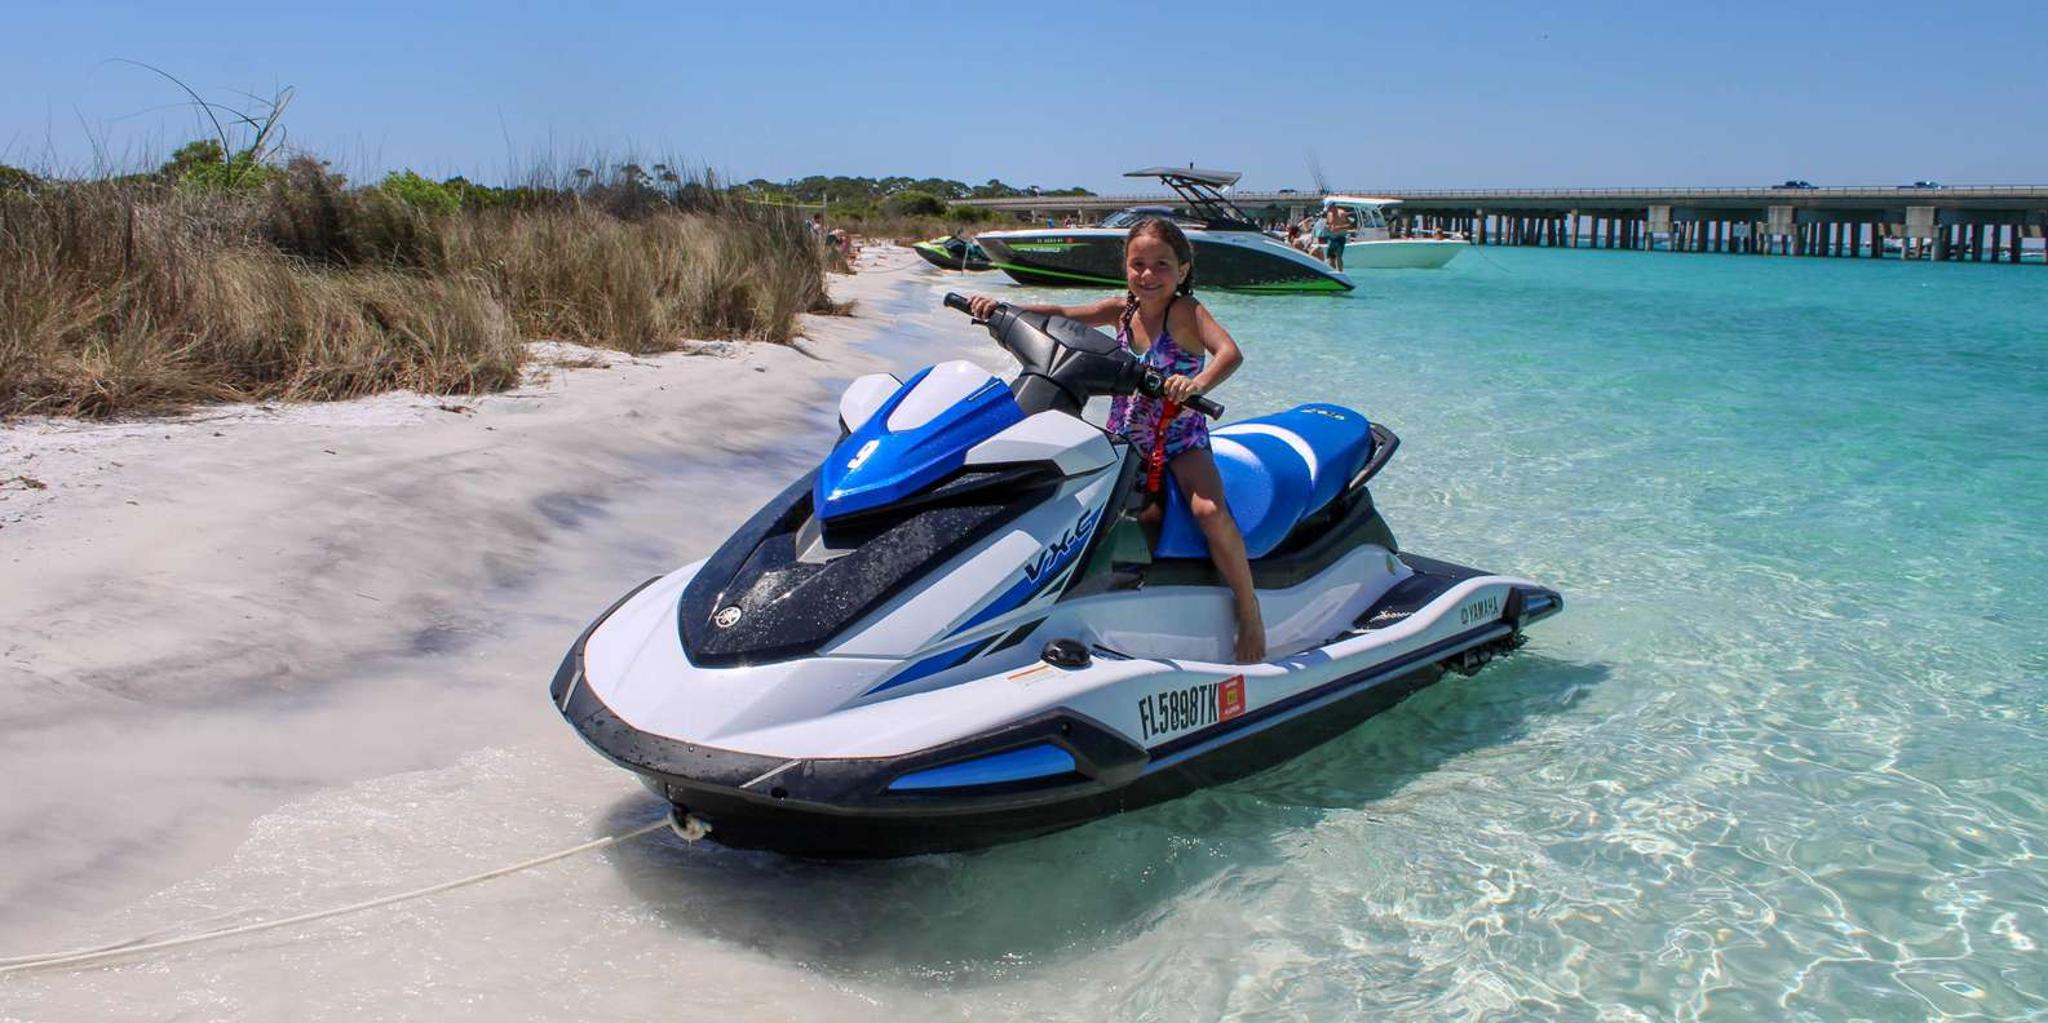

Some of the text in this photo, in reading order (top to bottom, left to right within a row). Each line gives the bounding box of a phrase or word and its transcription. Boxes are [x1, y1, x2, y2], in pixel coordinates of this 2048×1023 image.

[847, 439, 880, 469] 9
[1467, 594, 1498, 624] YAMAHA
[1138, 682, 1218, 740] FL5898TK
